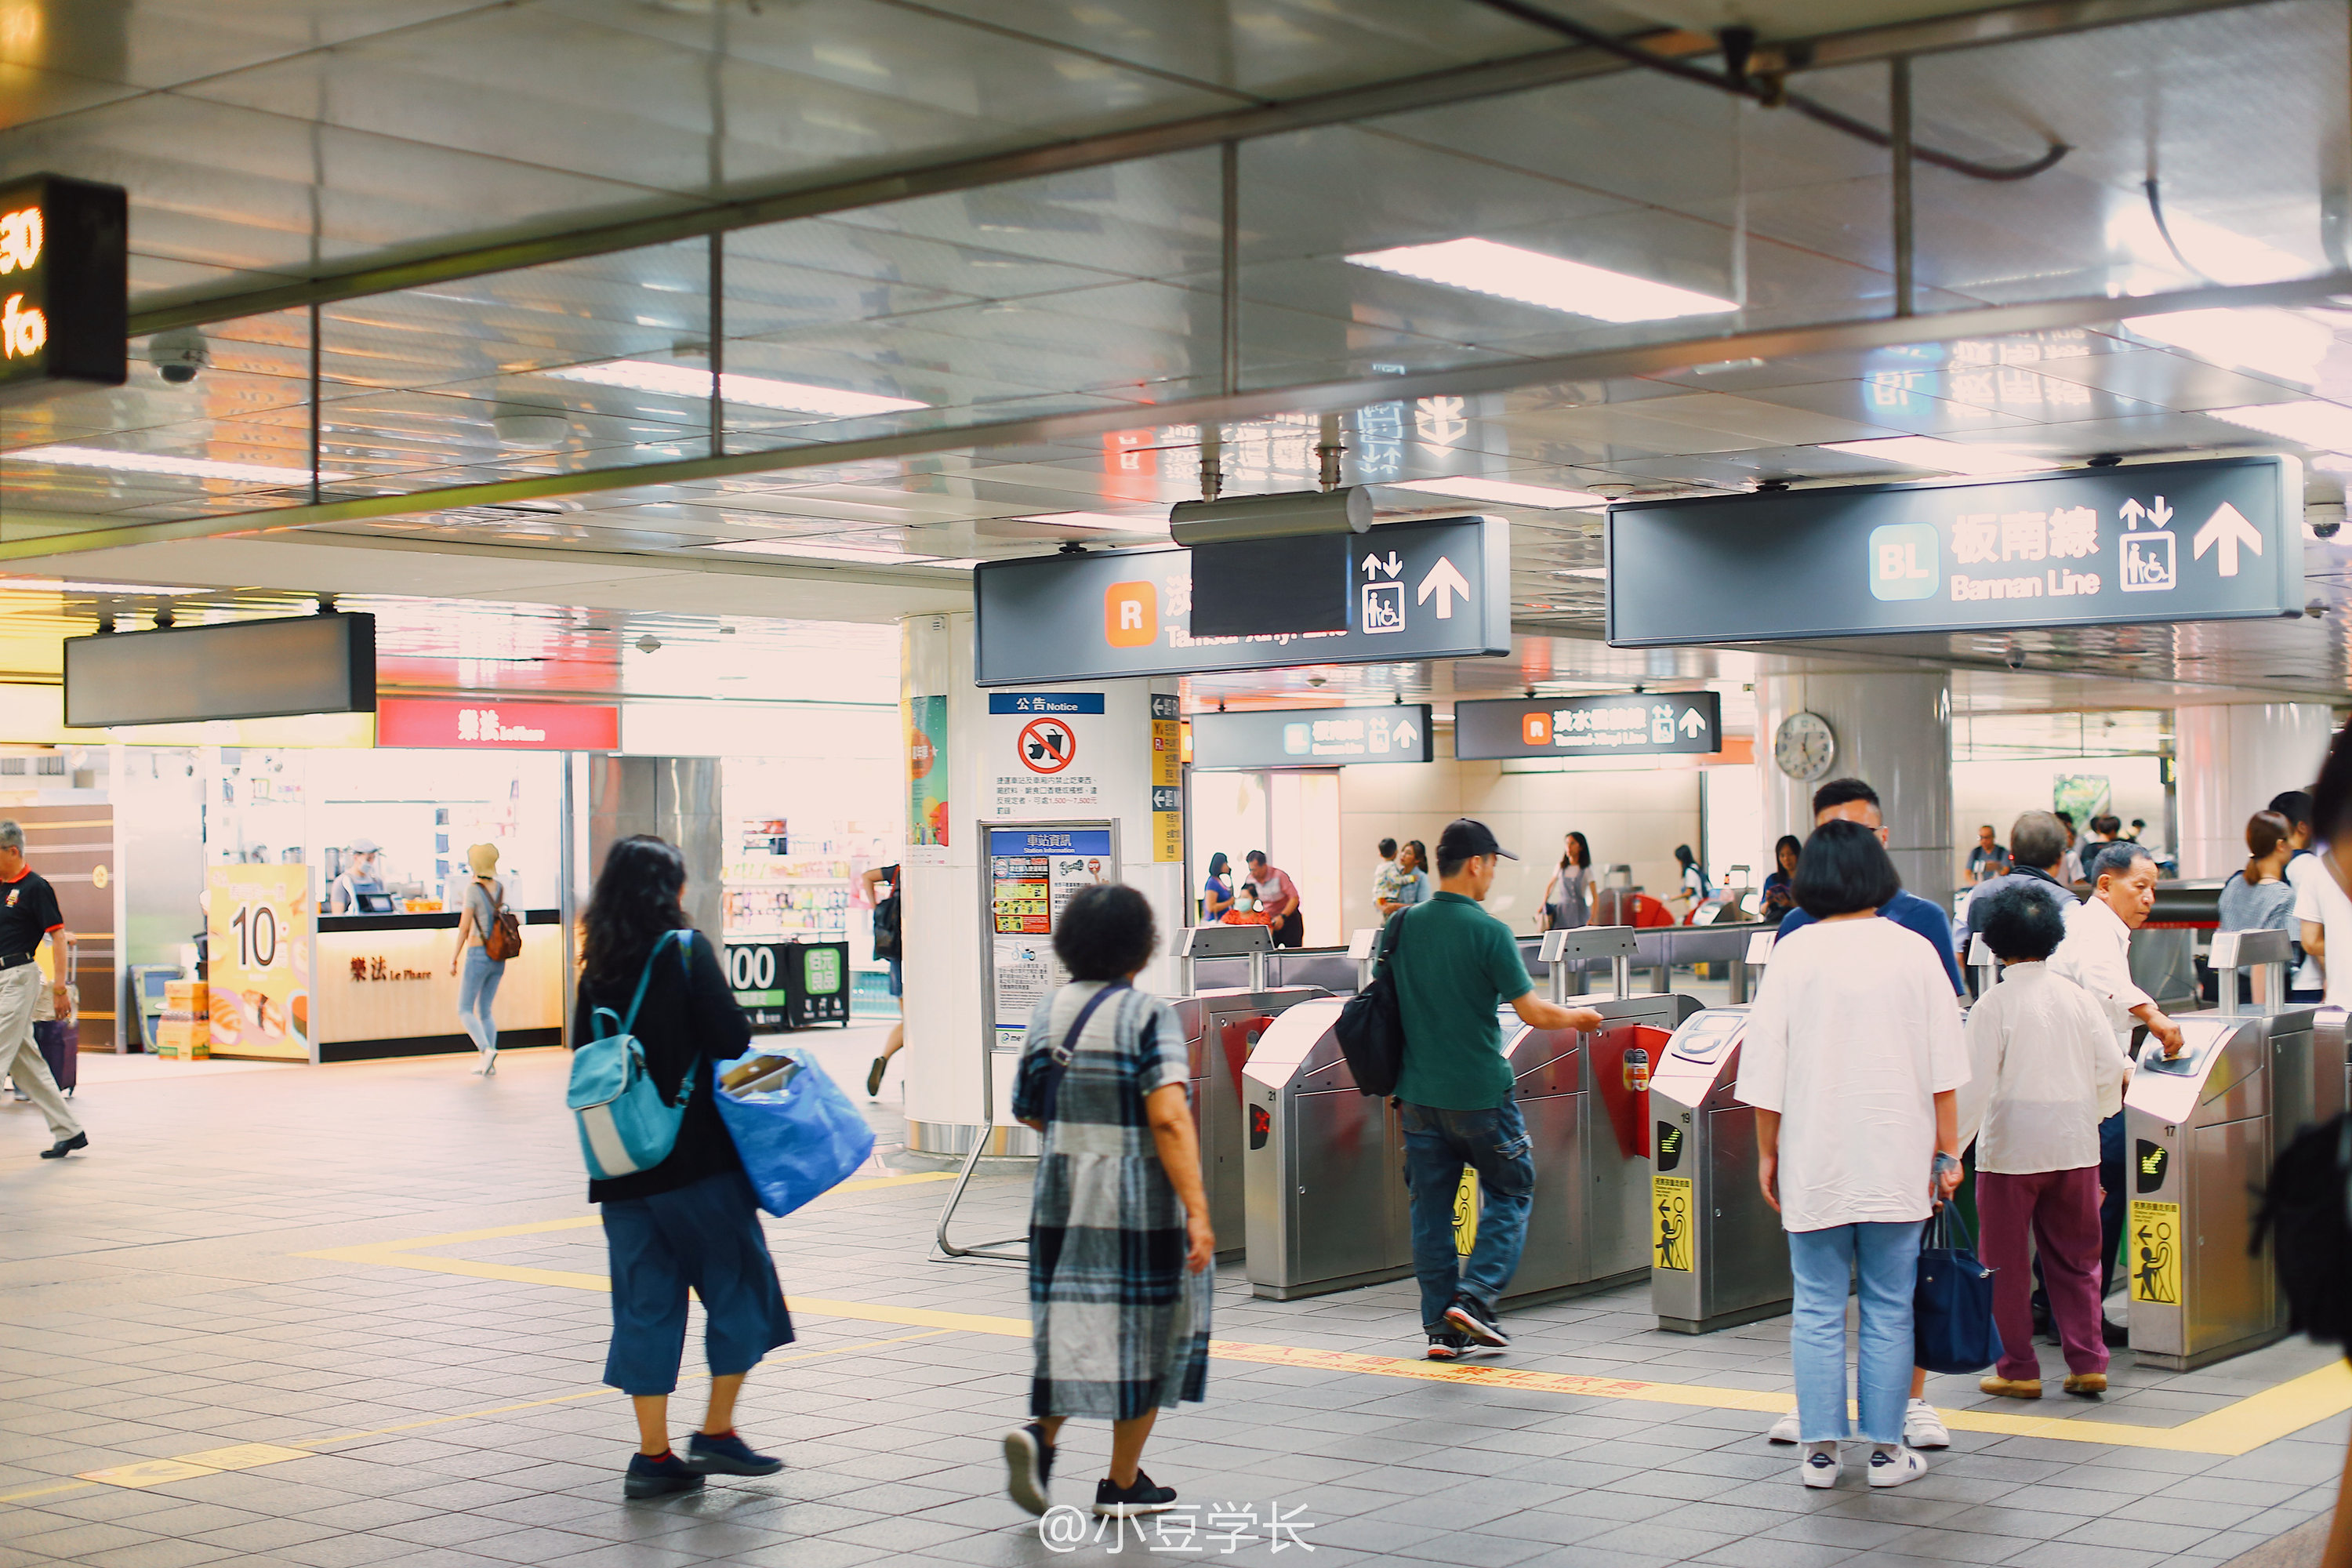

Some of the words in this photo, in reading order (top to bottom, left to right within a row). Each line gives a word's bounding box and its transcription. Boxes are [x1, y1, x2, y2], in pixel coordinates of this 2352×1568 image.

[1951, 505, 2101, 564] 板南線
[1878, 543, 1929, 580] BL
[1951, 575, 2042, 601] Bannan
[2047, 568, 2102, 597] Line
[1120, 600, 1142, 630] R
[1016, 696, 1047, 711] 公告
[1047, 702, 1079, 712] Notice
[1026, 834, 1072, 847] 車站資訊
[232, 906, 276, 967] 10
[350, 956, 387, 982] 樂法
[1269, 1091, 1276, 1102] 21
[1681, 1112, 1691, 1123] 19
[2164, 1125, 2176, 1137] 17
[1465, 1376, 1501, 1385] the
[1576, 1386, 1627, 1396] Line
